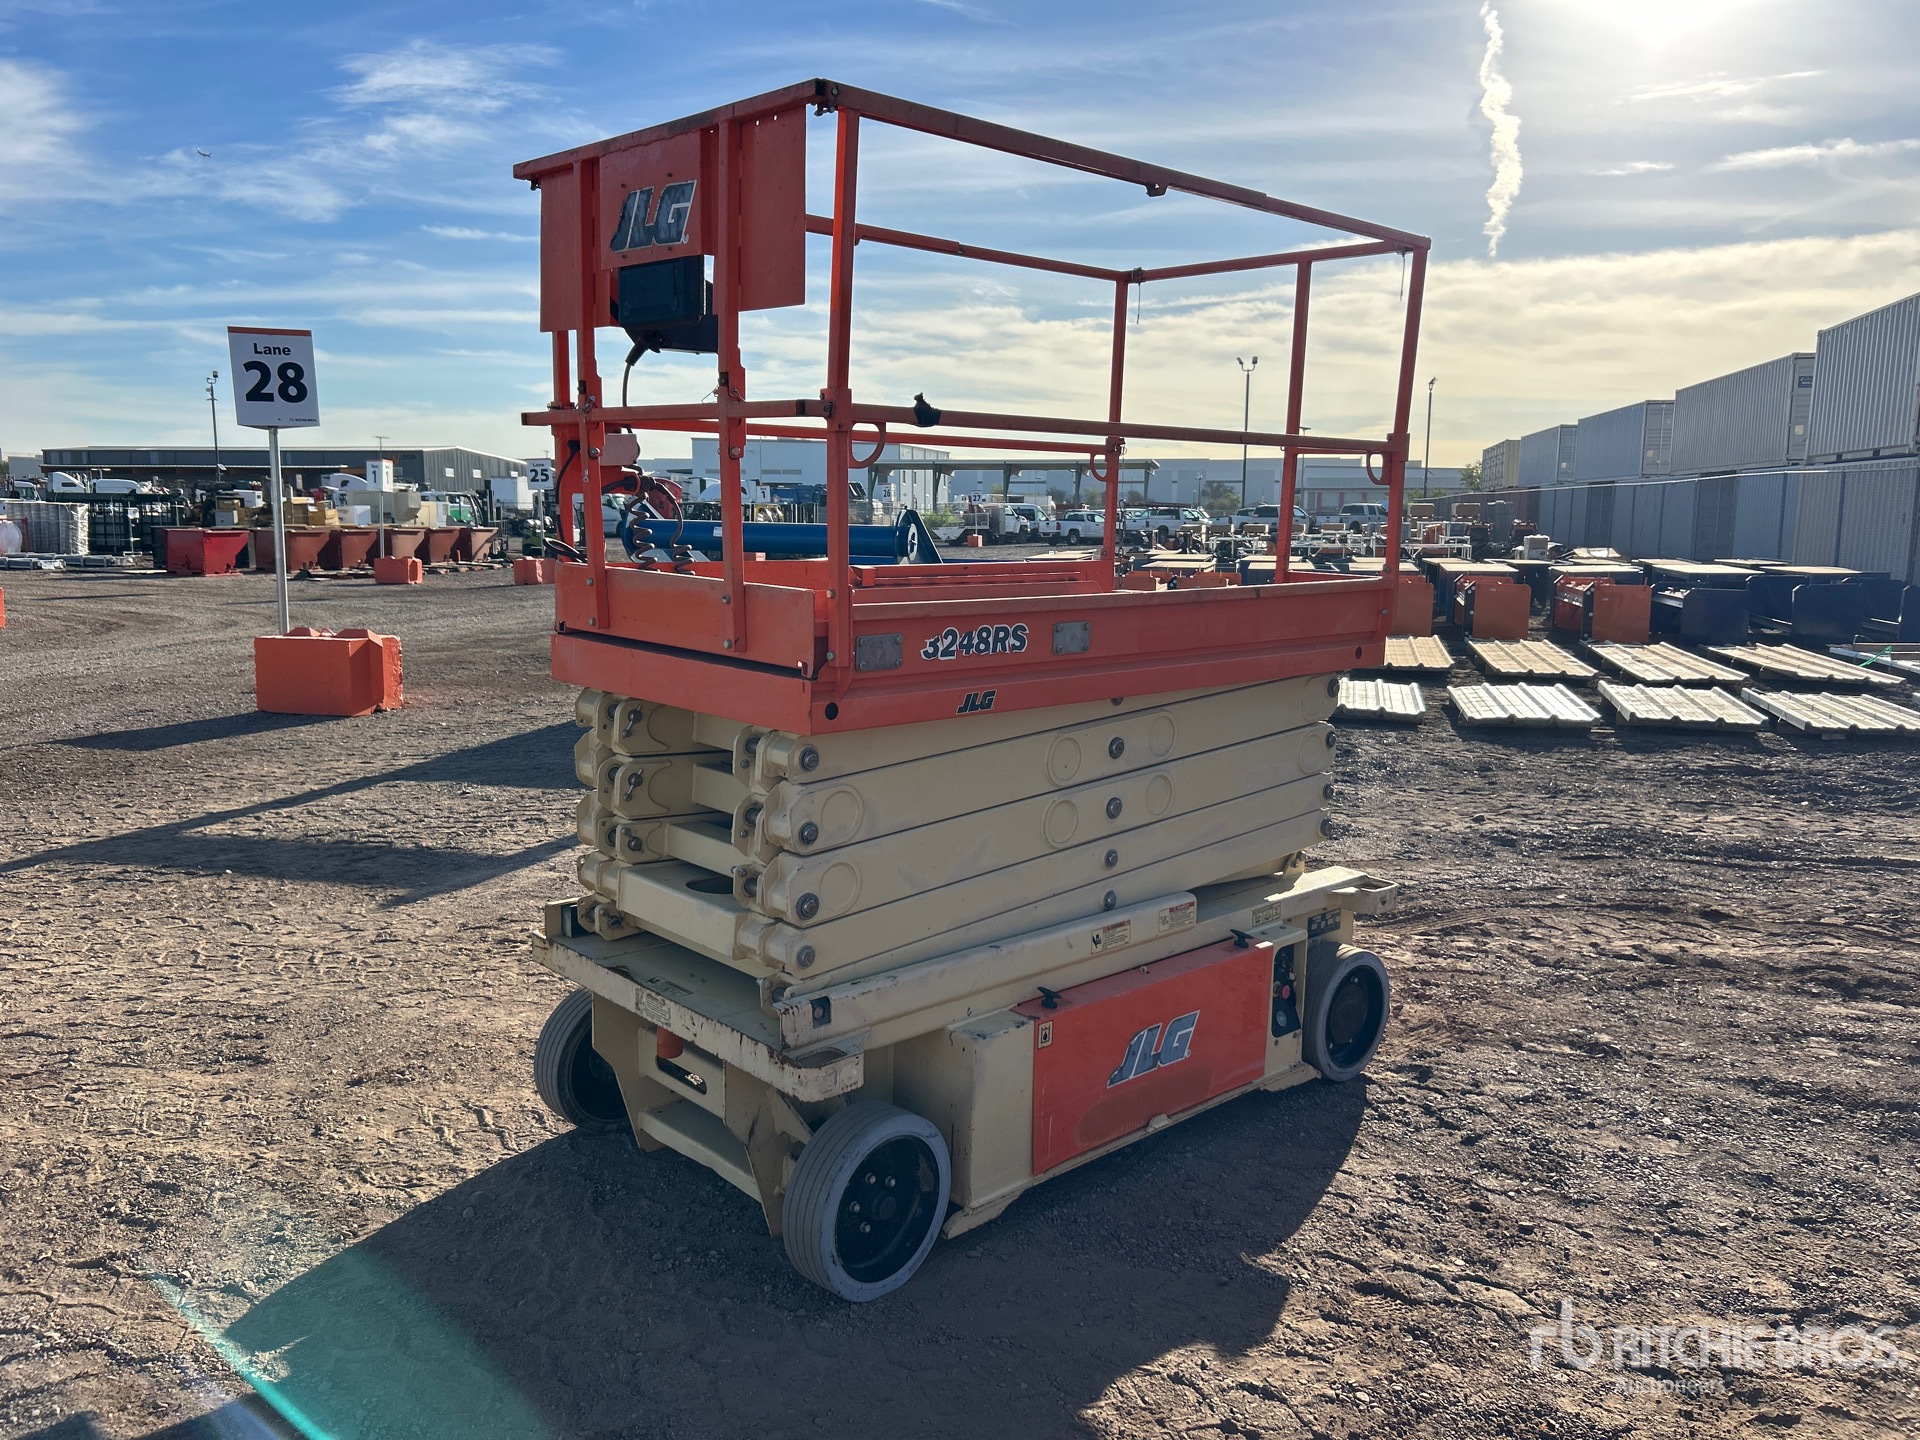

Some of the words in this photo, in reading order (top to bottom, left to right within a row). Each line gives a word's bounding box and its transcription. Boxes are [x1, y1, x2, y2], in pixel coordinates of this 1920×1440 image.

[609, 179, 698, 253] JLG
[253, 342, 291, 356] Lane
[243, 360, 308, 403] 28
[371, 469, 377, 484] 1
[530, 468, 550, 483] 25
[761, 490, 766, 499] 1
[883, 489, 891, 498] 26
[972, 494, 981, 502] 27
[956, 689, 997, 714] JLG
[1106, 1009, 1200, 1089] JLG
